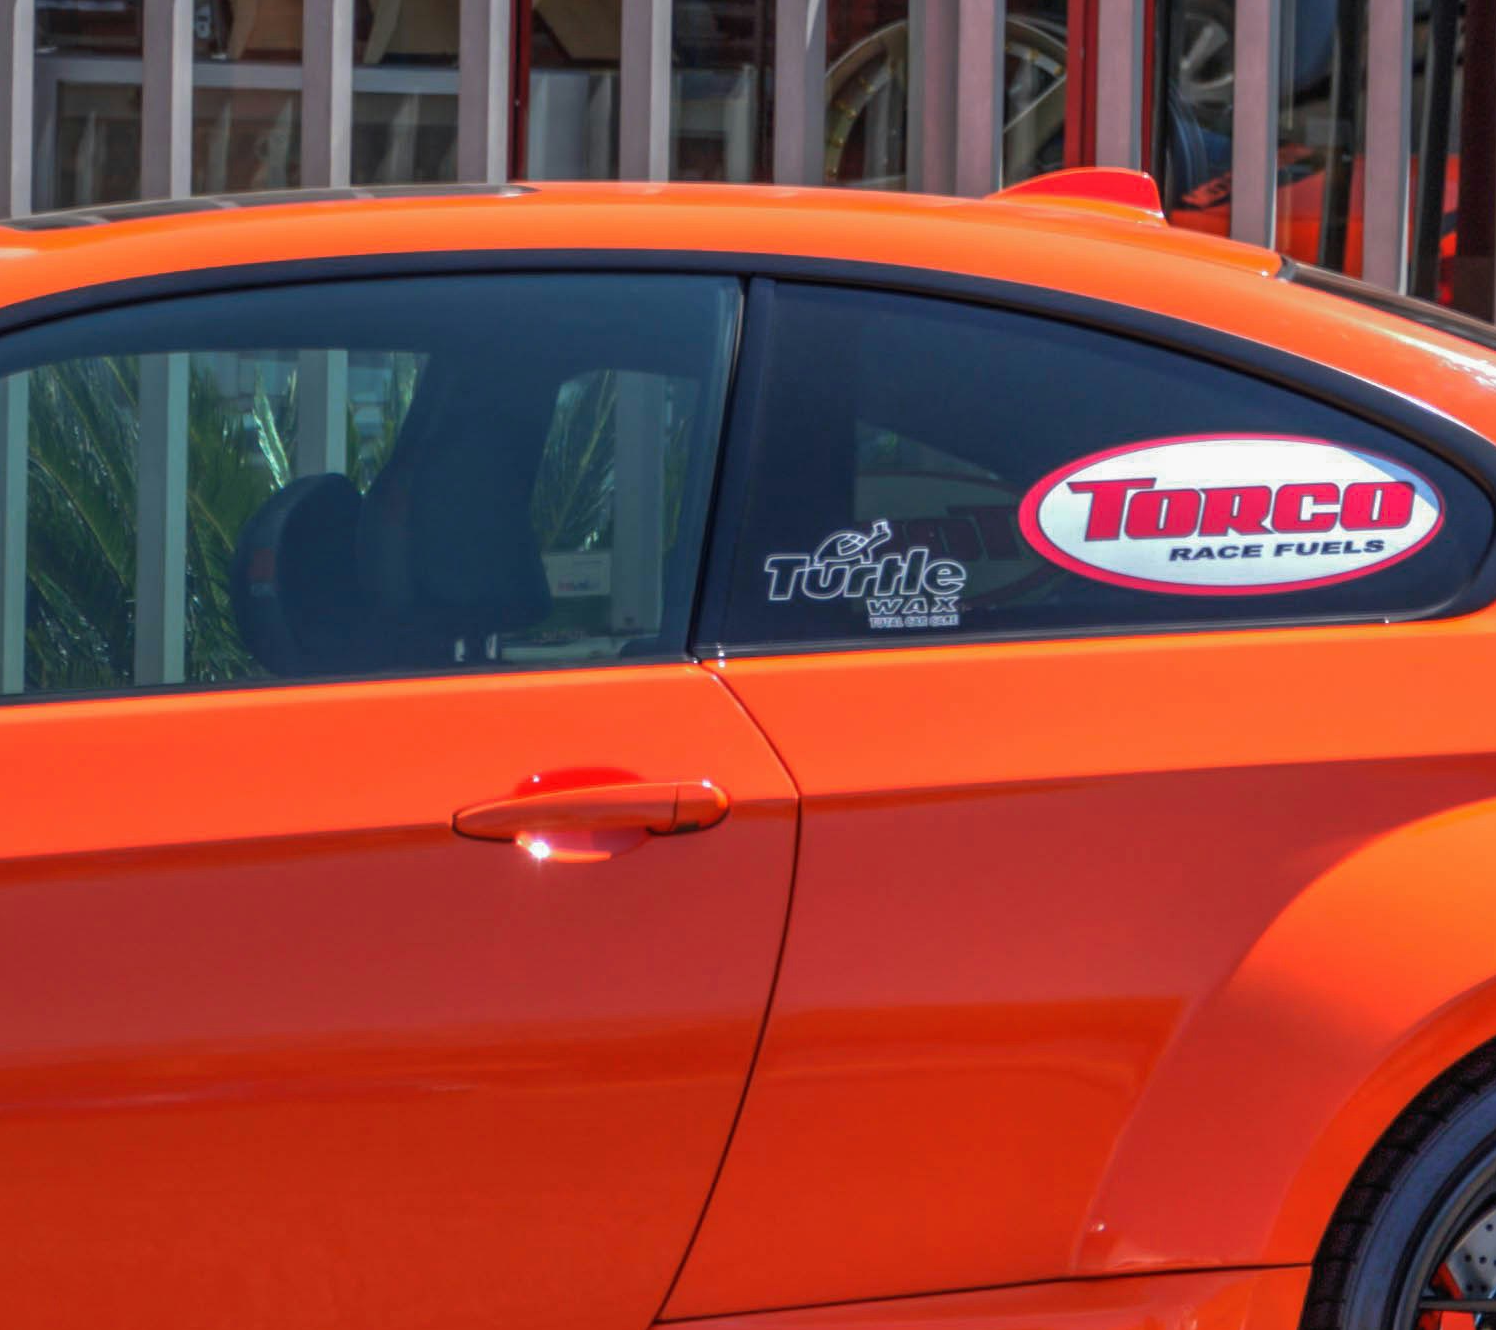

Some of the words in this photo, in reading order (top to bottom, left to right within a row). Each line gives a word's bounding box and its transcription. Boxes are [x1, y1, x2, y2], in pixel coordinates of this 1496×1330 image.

[1066, 476, 1416, 542] TORCO
[1168, 543, 1262, 563] RACE
[1272, 540, 1385, 558] FUELS
[764, 546, 966, 600] Turtle
[866, 597, 960, 615] WAX
[869, 616, 904, 628] TOTAL
